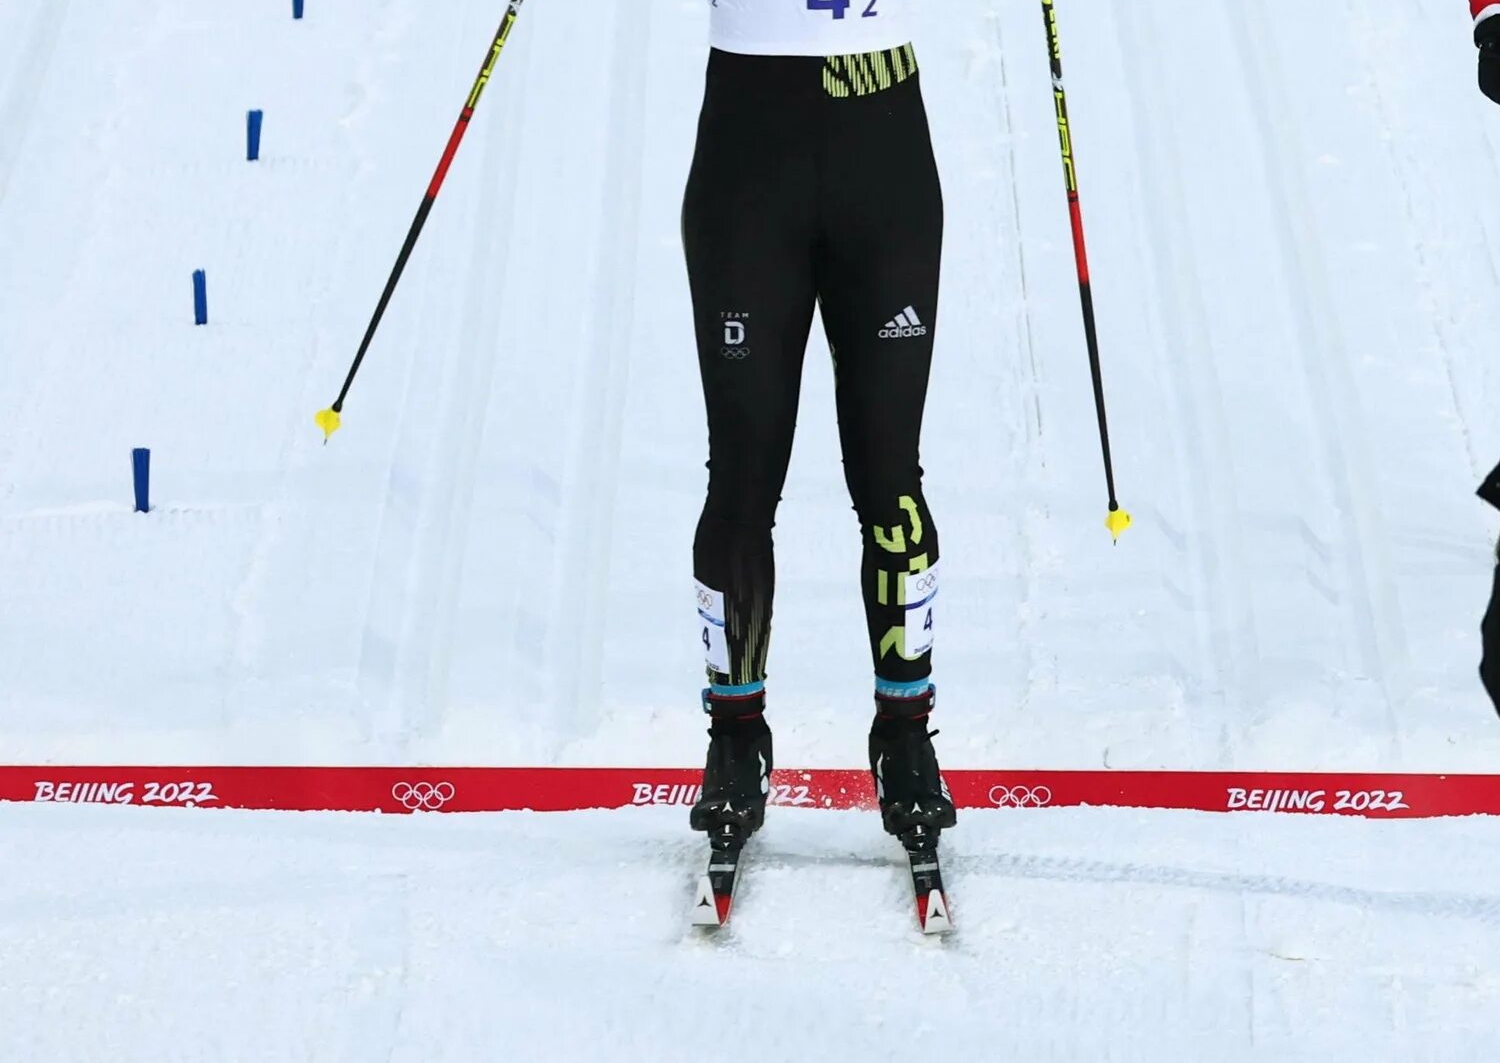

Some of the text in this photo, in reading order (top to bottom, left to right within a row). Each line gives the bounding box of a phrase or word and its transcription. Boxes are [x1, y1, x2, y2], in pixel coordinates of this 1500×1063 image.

[878, 325, 927, 339] adidas
[923, 606, 933, 631] 4
[702, 626, 711, 652] 4
[34, 780, 220, 805] BEIJING 2022
[632, 783, 816, 806] BEIJI 022
[1226, 787, 1411, 813] BEIJING 2022
